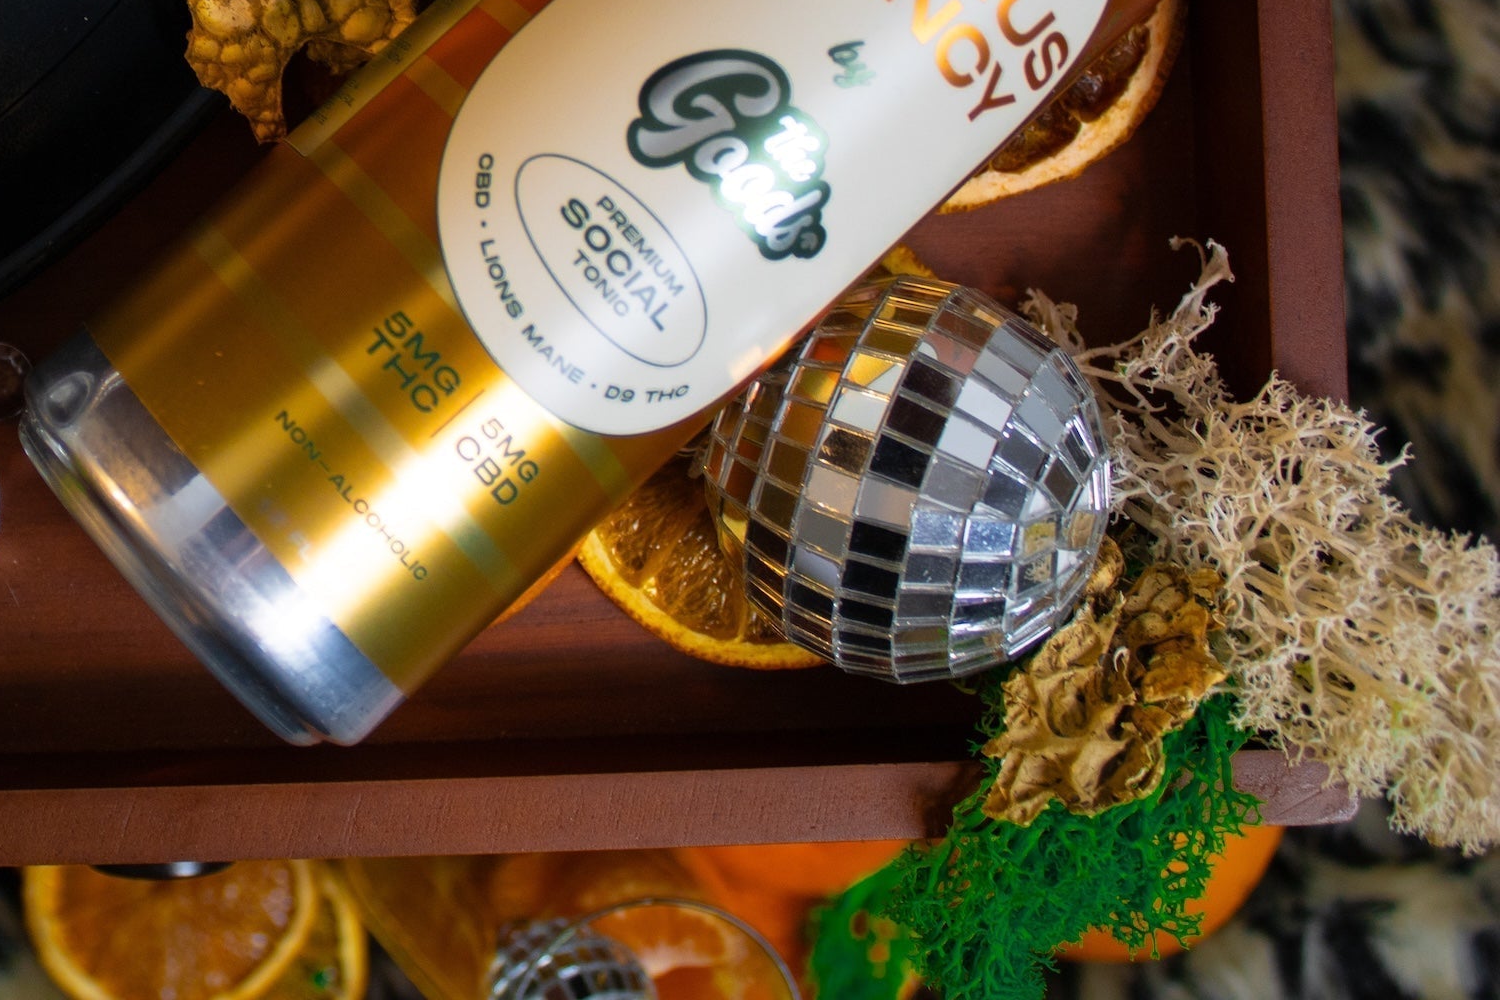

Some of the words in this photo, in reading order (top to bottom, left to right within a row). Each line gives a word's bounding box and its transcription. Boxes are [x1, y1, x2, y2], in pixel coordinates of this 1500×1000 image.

[474, 153, 494, 210] CBD
[630, 50, 828, 258] Goods
[764, 114, 822, 183] the
[479, 238, 524, 320] LIONS
[560, 197, 667, 332] SOCIAL
[596, 195, 685, 298] PREMIUM
[572, 249, 630, 318] TONIC
[365, 327, 440, 414] THC
[384, 310, 462, 397] 5MG
[521, 323, 586, 386] MANE
[604, 383, 636, 404] D9
[645, 383, 691, 404] THC
[455, 435, 519, 506] CBD
[480, 417, 540, 484] 5MG
